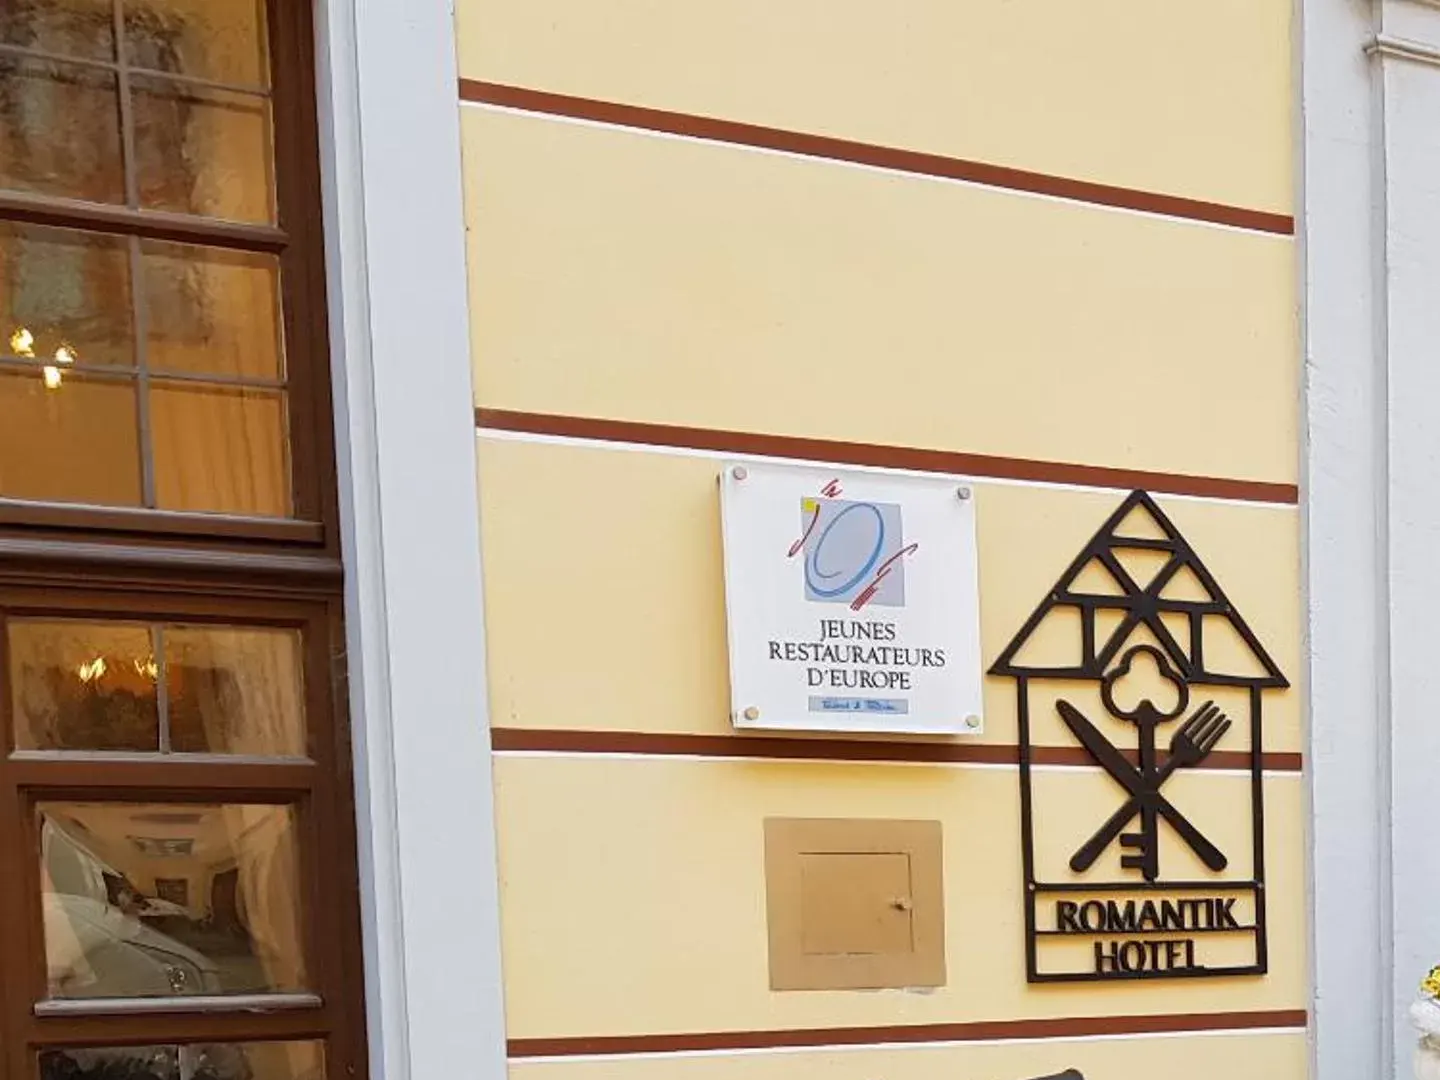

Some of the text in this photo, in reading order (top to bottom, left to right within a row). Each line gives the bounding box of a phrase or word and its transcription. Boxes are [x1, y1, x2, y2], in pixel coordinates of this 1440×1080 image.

[820, 620, 896, 641] JEUNES
[768, 641, 946, 667] RESTAURATEURS
[807, 668, 912, 690] D'EUROPE
[1056, 898, 1239, 931] ROMANTIK
[1094, 939, 1205, 974] HOTEL
